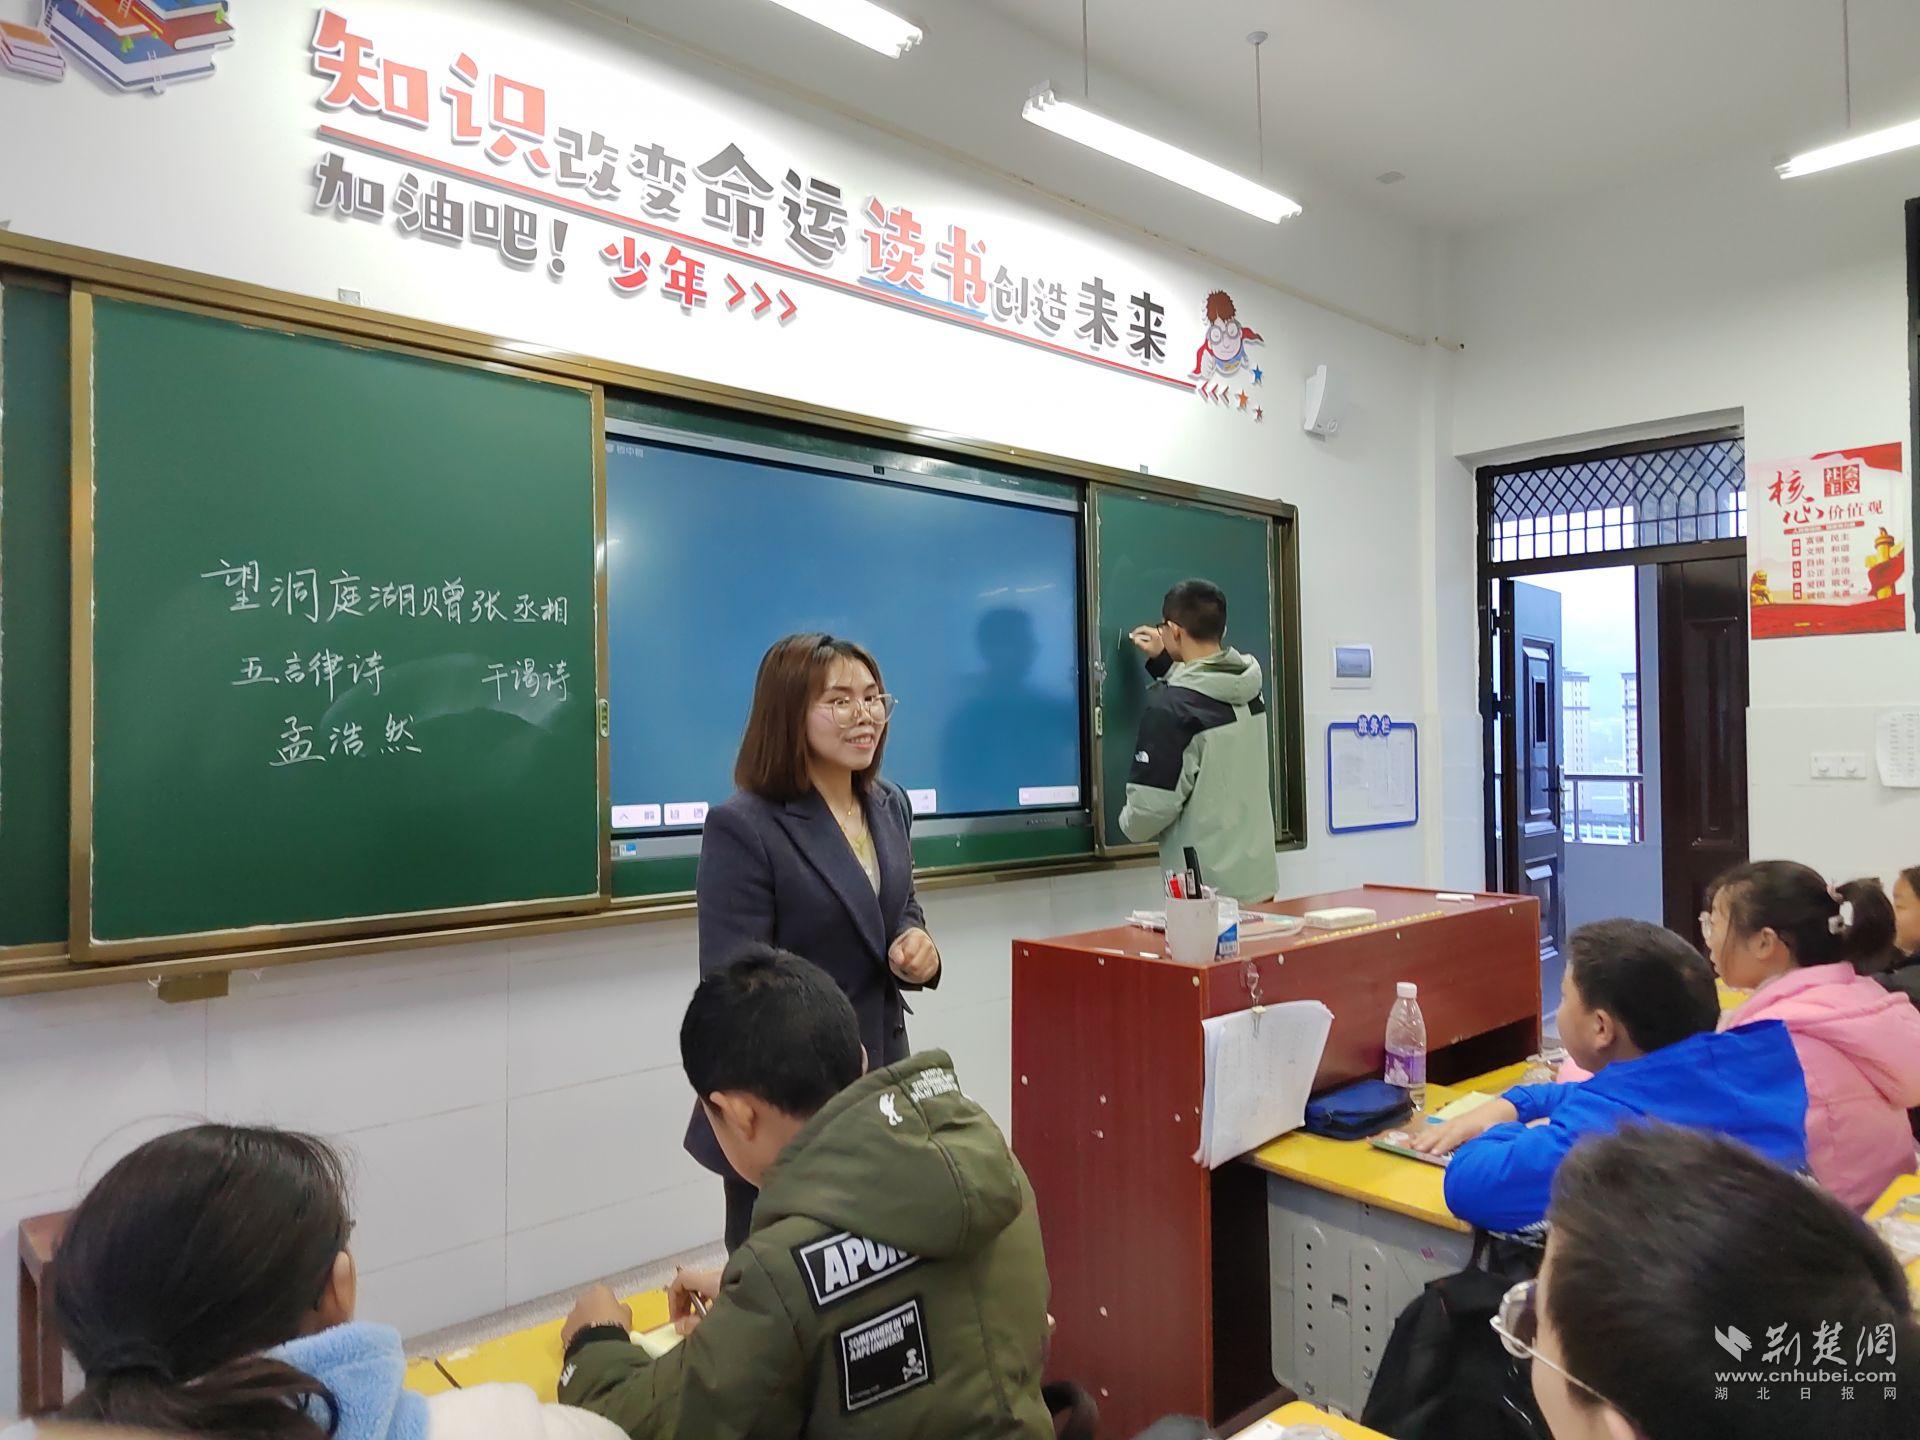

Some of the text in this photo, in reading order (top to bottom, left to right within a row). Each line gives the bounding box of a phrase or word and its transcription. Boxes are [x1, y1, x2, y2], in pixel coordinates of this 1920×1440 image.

[600, 235, 708, 308] 少年
[231, 648, 386, 702] 五言律诗
[268, 712, 423, 767] 孟浩然
